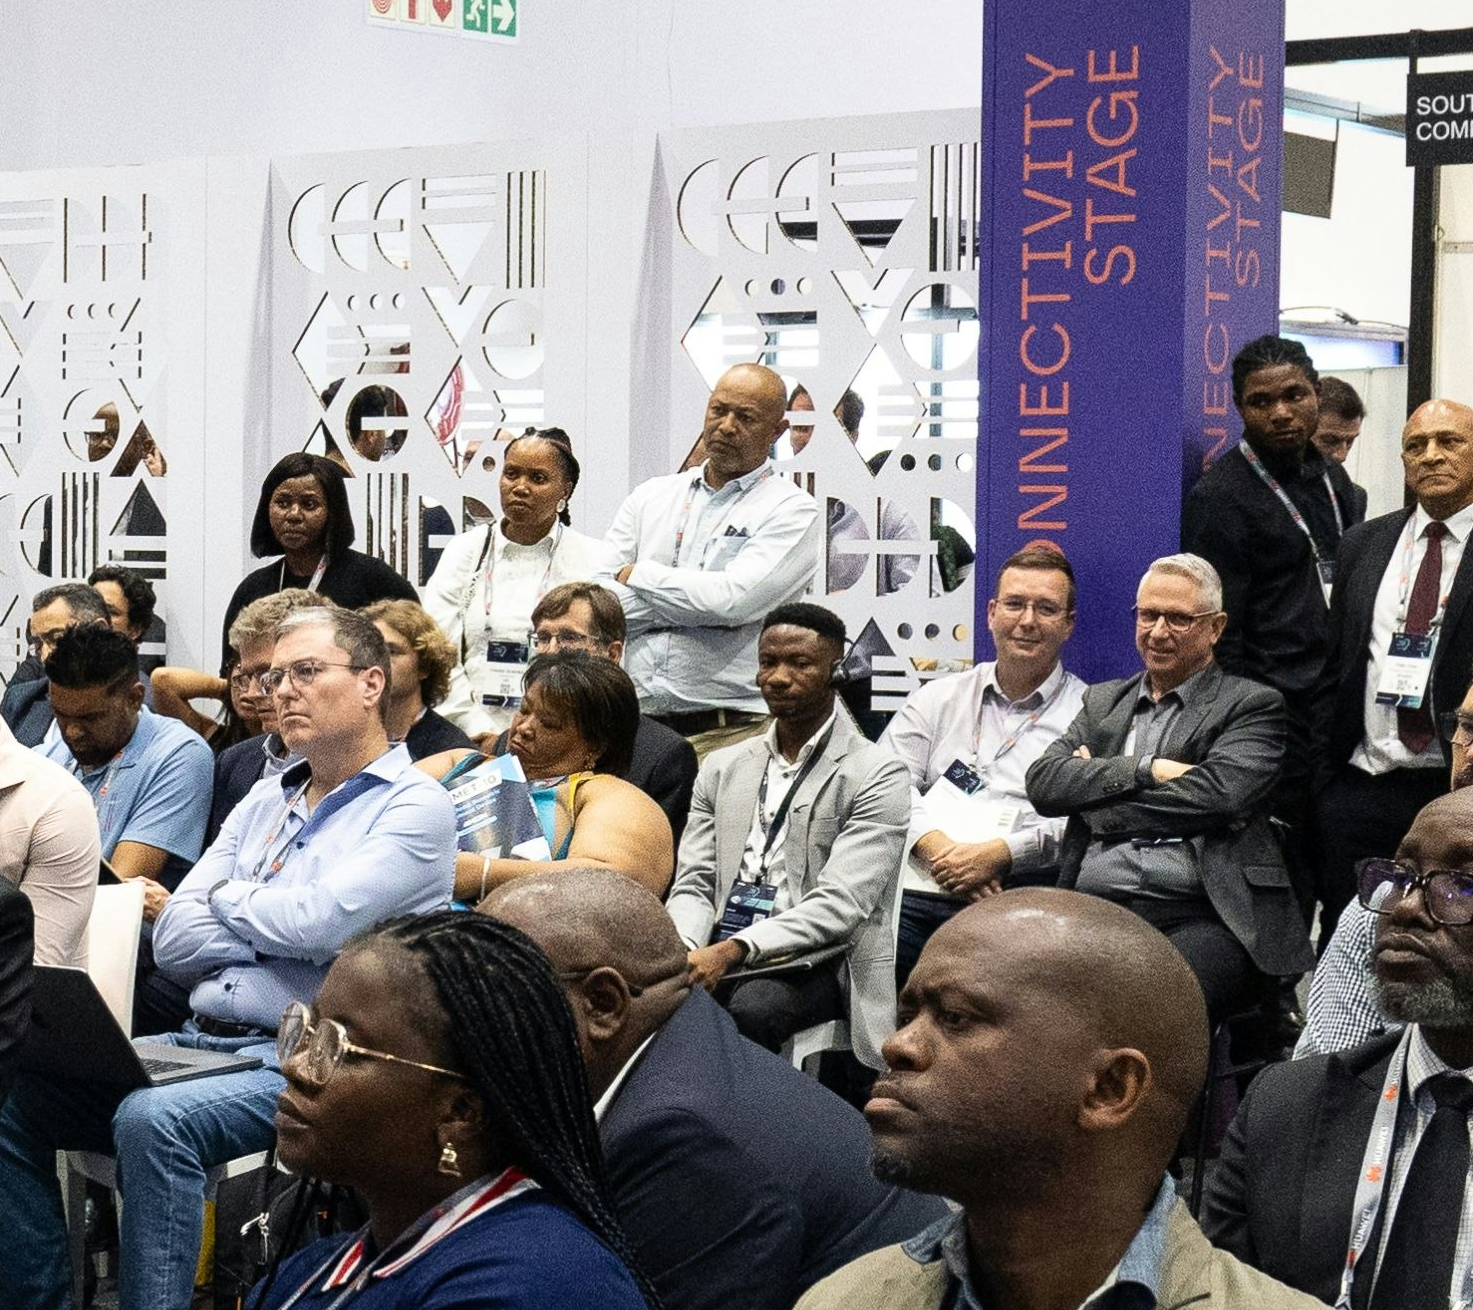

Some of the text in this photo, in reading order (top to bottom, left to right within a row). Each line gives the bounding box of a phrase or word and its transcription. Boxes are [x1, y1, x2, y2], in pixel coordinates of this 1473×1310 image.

[1083, 46, 1140, 286] STAGE
[1201, 46, 1236, 470] NECTIVITY
[1235, 52, 1264, 288] STAGE
[1018, 53, 1075, 557] NNECTIVITY
[1352, 1208, 1372, 1249] HUAWEI
